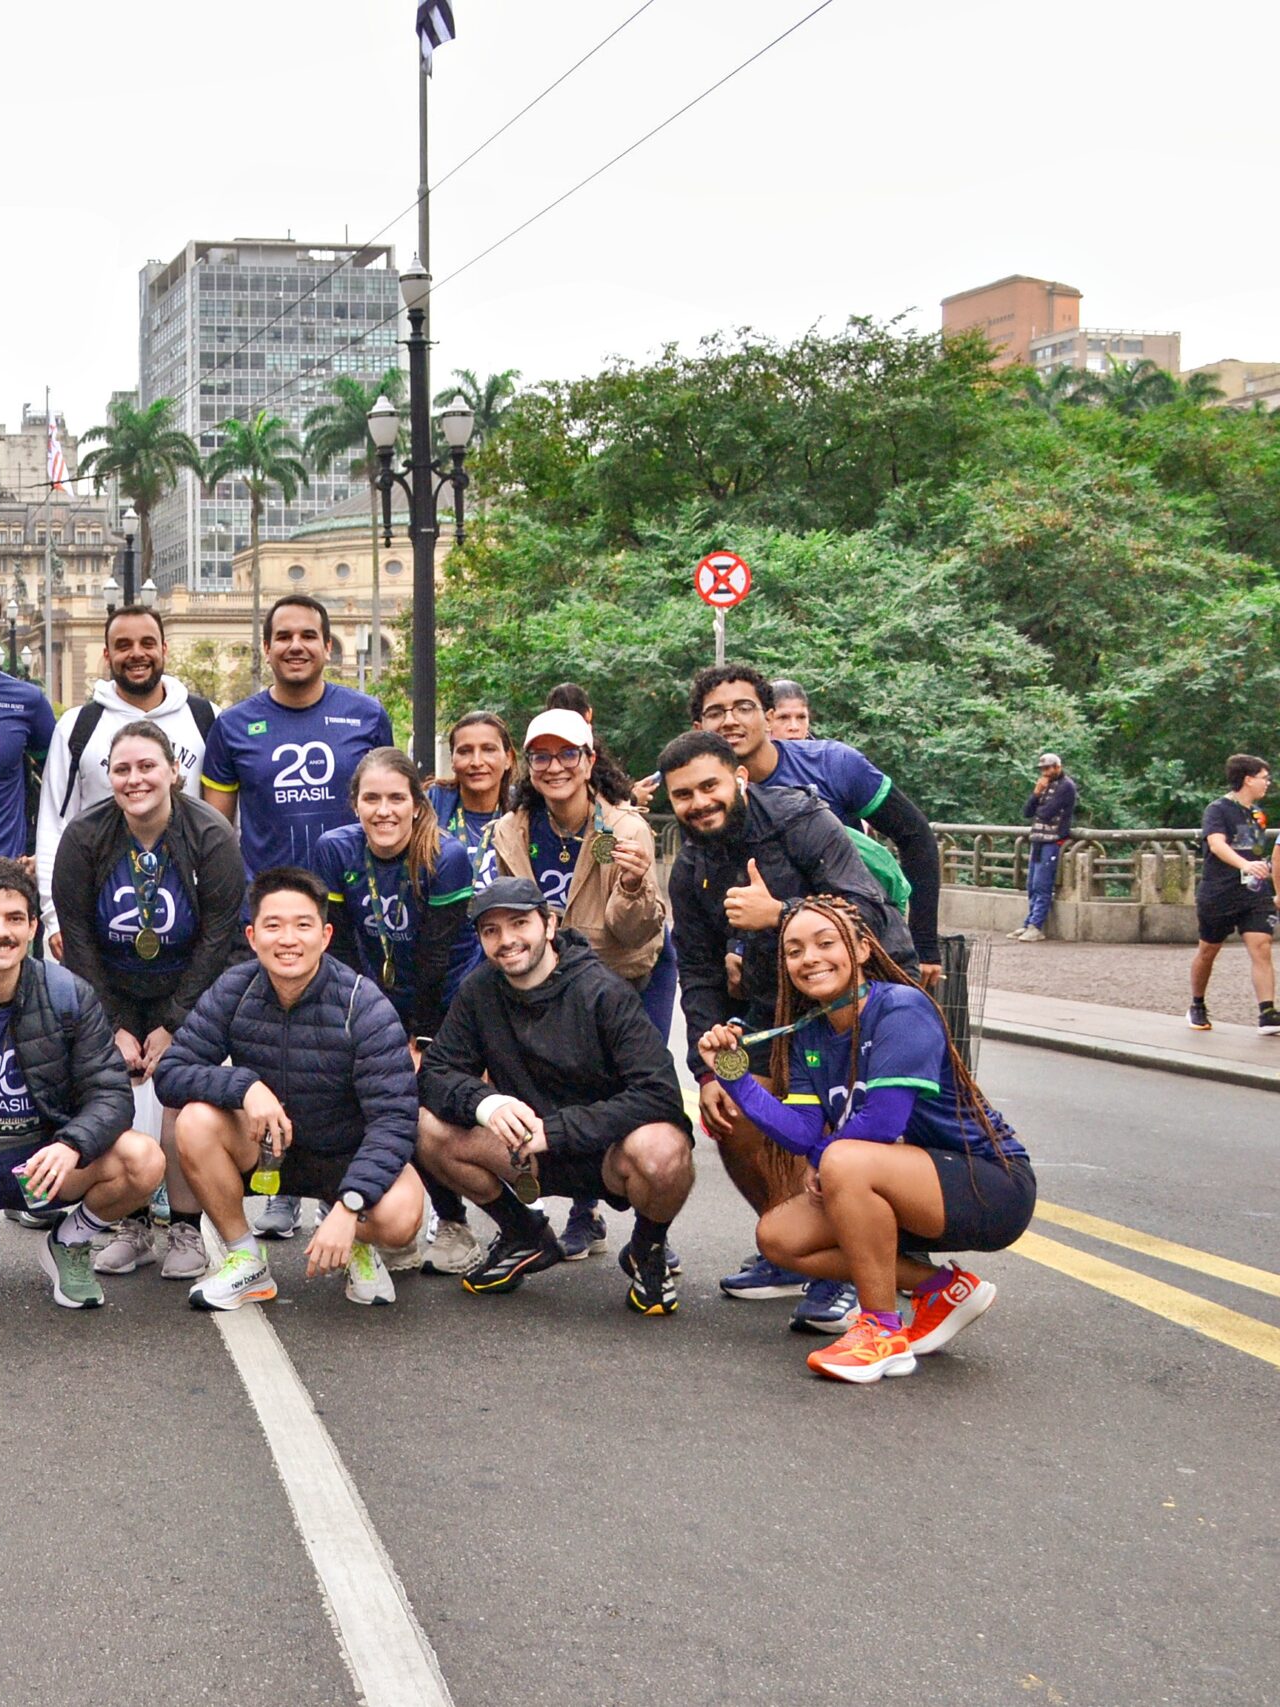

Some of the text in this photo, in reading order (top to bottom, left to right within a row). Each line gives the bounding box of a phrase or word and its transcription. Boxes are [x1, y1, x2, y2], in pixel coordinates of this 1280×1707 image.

[272, 741, 335, 788] 20
[274, 786, 336, 804] BRASIL
[108, 885, 176, 934] 20
